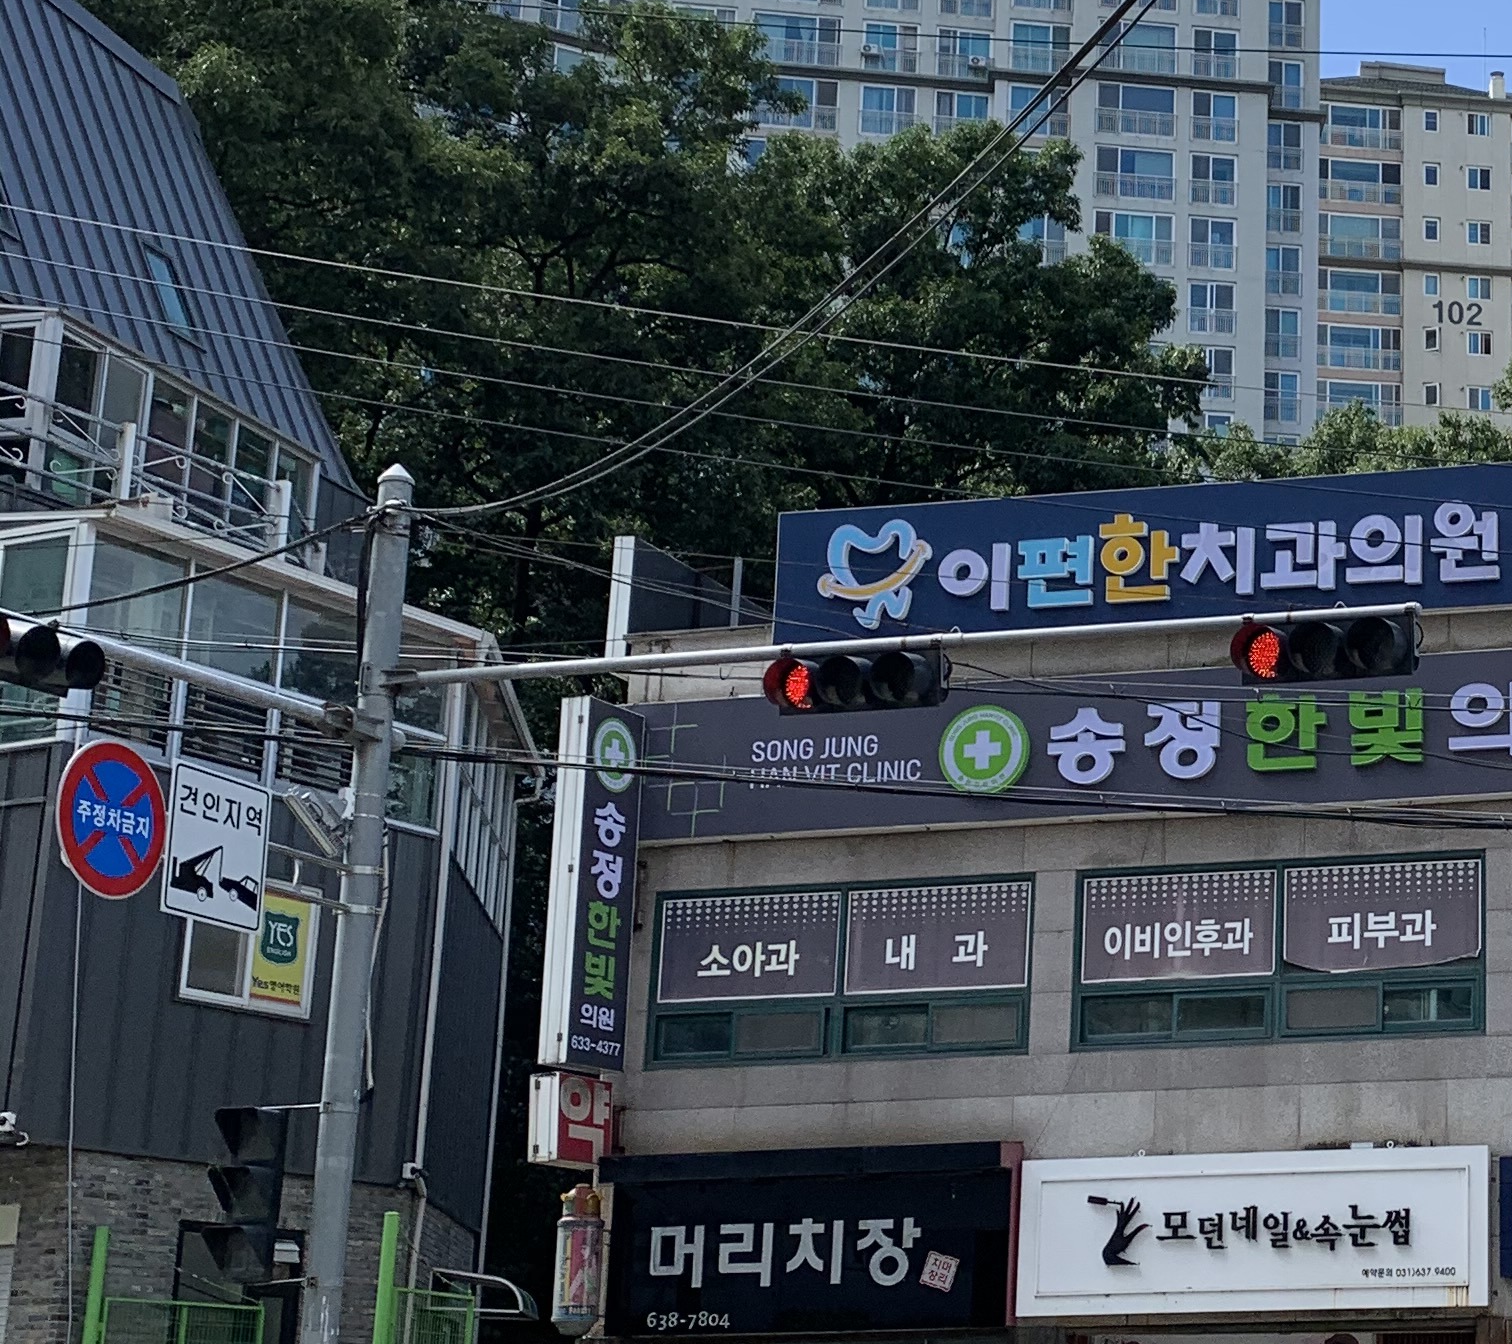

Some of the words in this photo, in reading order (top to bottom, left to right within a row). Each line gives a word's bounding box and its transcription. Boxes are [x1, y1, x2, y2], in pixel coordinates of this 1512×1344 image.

[1432, 300, 1483, 326] 102
[938, 499, 1501, 612] 이편한치과의원
[751, 739, 814, 763] SONG
[820, 734, 879, 759] JUNG
[847, 759, 922, 783] CLINIC
[76, 799, 150, 839] 주정차금지
[179, 784, 263, 836] 견인지역
[268, 920, 294, 947] YES
[1104, 917, 1253, 960] 이비인후과
[1327, 908, 1437, 949] 피부과
[697, 940, 800, 977] 소아과
[579, 1003, 615, 1032] 의원
[571, 1034, 621, 1056] 633-4377
[1155, 1204, 1413, 1251] 모던네일&속눈썹
[649, 1217, 922, 1288] 머리치장
[646, 1311, 731, 1330] 638-7804
